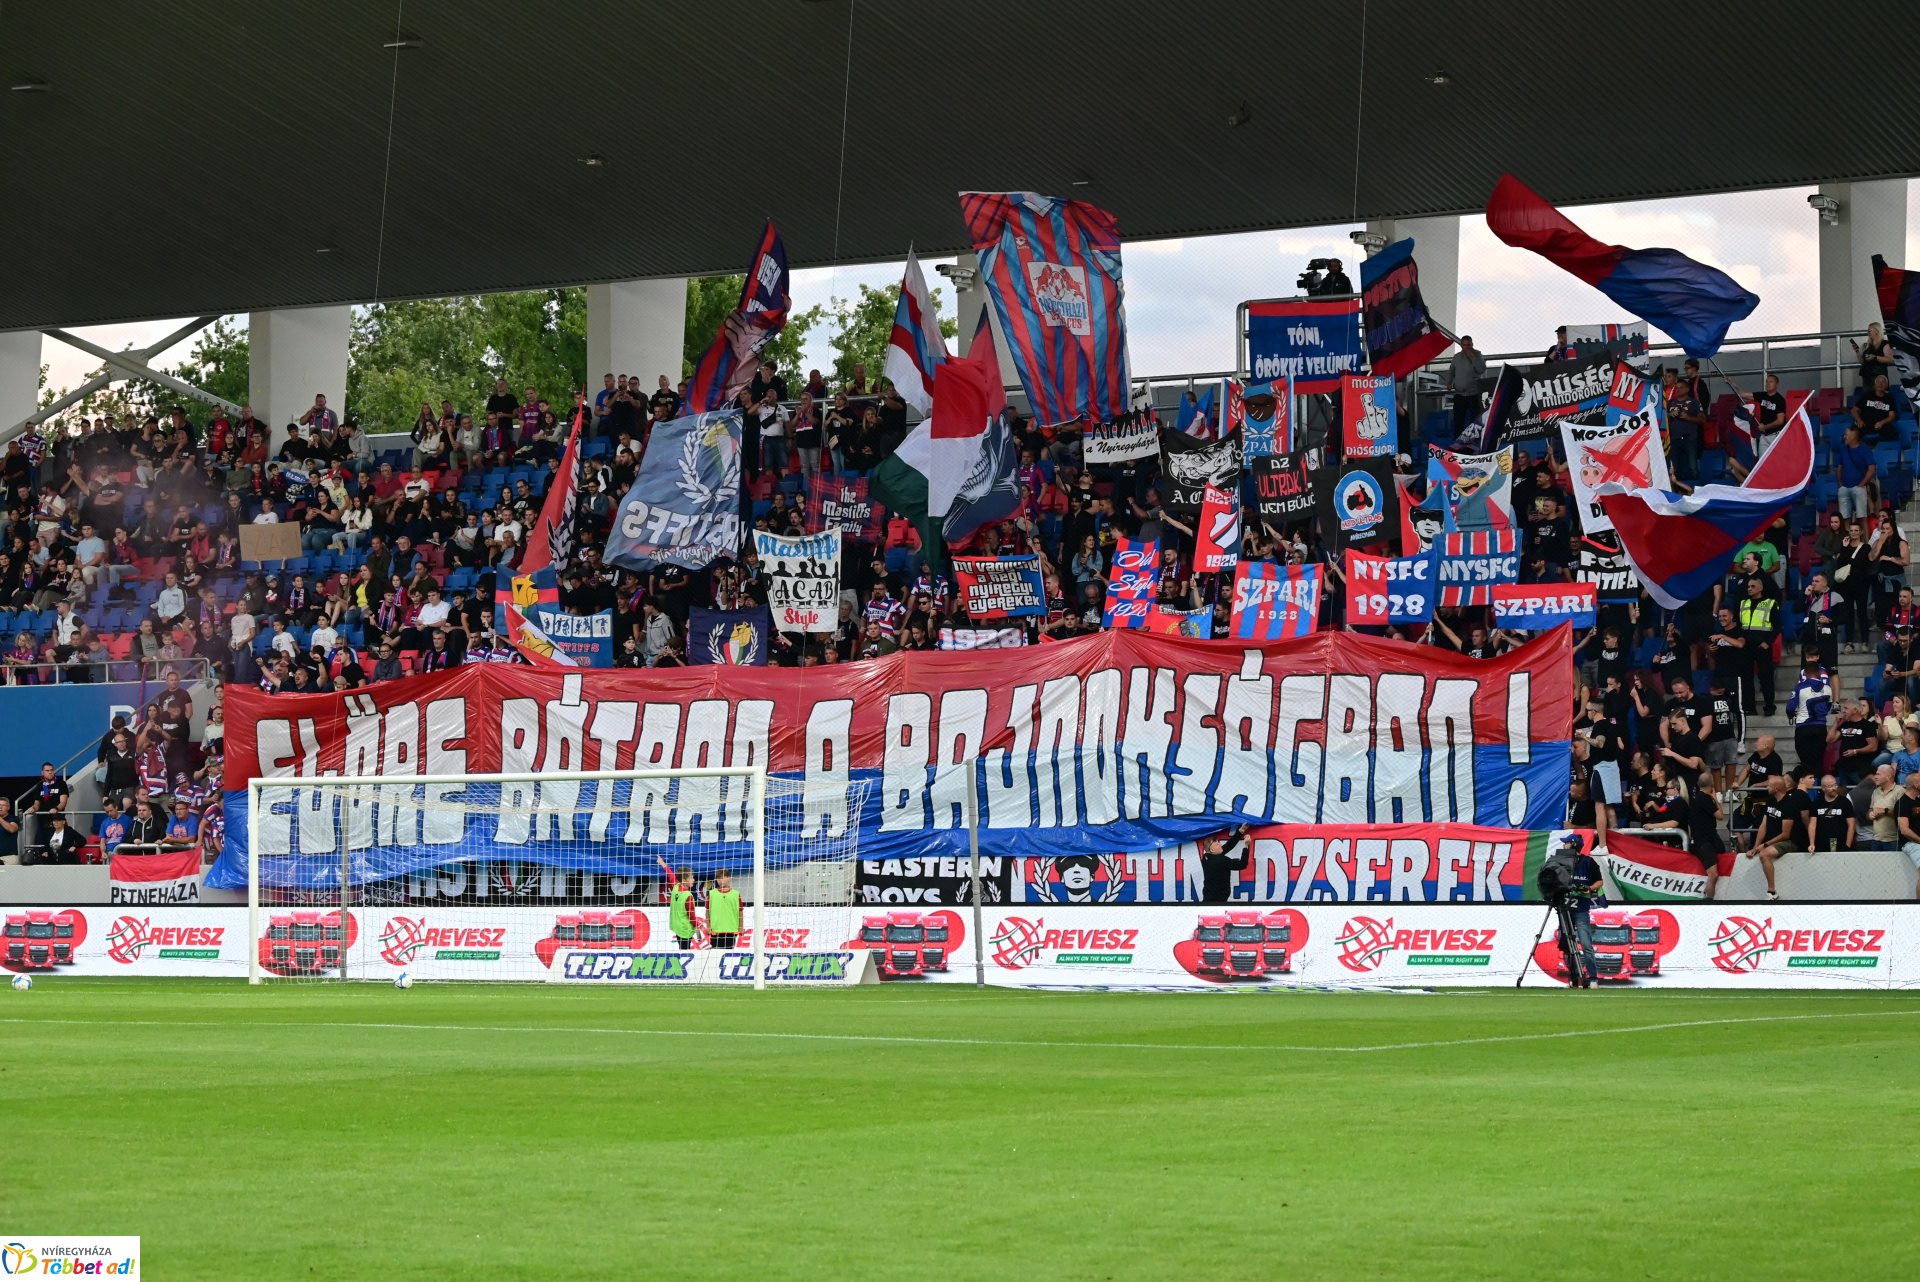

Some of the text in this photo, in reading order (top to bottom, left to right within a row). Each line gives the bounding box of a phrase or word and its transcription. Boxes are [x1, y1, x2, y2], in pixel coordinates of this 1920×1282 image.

[1287, 322, 1324, 348] TÓNI,
[1255, 352, 1358, 378] ÖRÖKKÉ VELÜNK!
[1536, 363, 1614, 400] HŰSÉG
[1571, 411, 1650, 441] MOCSKOS
[1242, 436, 1283, 454] ZPARI
[1271, 457, 1290, 469] DZ
[1260, 502, 1286, 514] NEM
[1117, 549, 1157, 567] Old
[1206, 553, 1237, 568] 1928
[1440, 557, 1517, 581] NYSFC
[1353, 559, 1429, 581] NYSFC
[1576, 569, 1639, 590] ANTIFA
[1233, 577, 1319, 617] SZPARI
[1354, 594, 1425, 616] 1928
[1493, 594, 1594, 617] SZPARI
[784, 608, 819, 631] Style
[1107, 602, 1149, 617] 1928
[1258, 610, 1298, 620] 1928
[801, 699, 854, 840] A
[862, 856, 1002, 879] EASTERN
[1608, 858, 1706, 894] NYÍREGYHÁZ
[111, 882, 199, 905] PETNEHÁZA
